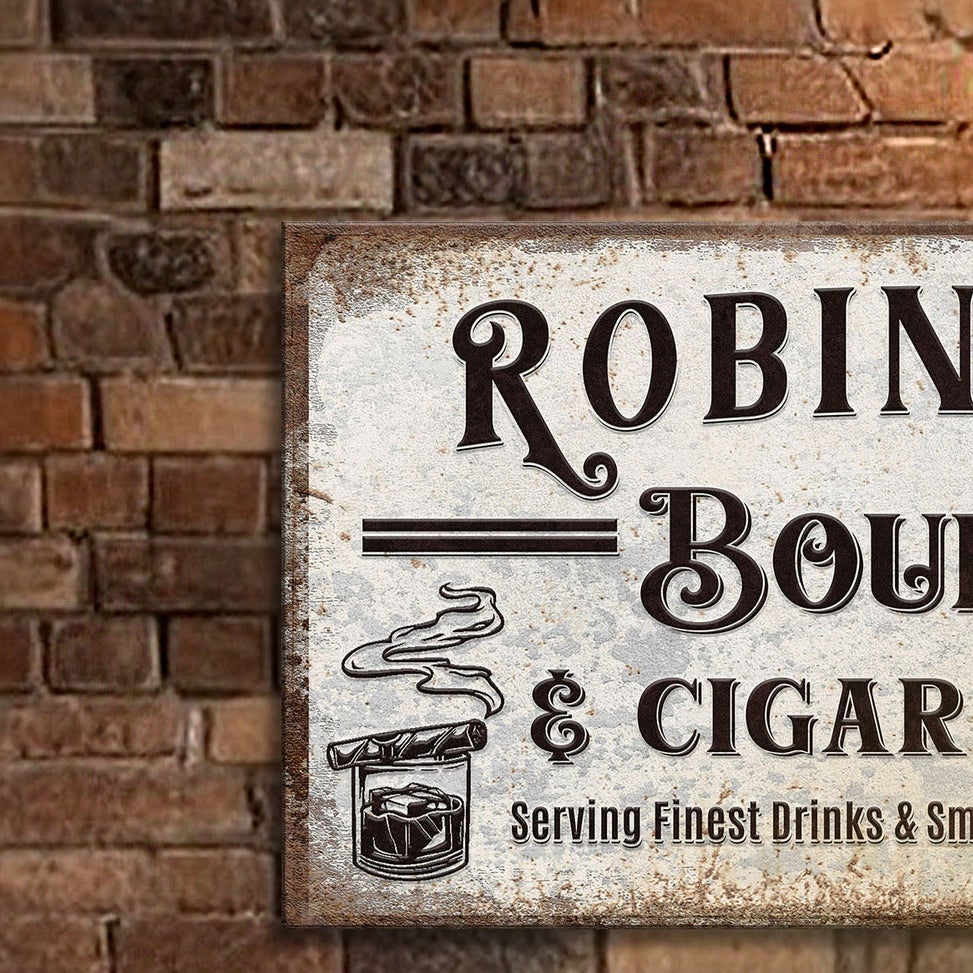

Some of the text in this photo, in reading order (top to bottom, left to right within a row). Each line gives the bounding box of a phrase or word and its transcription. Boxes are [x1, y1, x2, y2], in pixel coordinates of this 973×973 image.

[530, 668, 588, 764] &
[637, 678, 965, 756] CIGAR
[511, 801, 642, 846] Serving
[654, 801, 761, 842] Finest
[772, 801, 884, 842] Drinks
[894, 801, 918, 842] &
